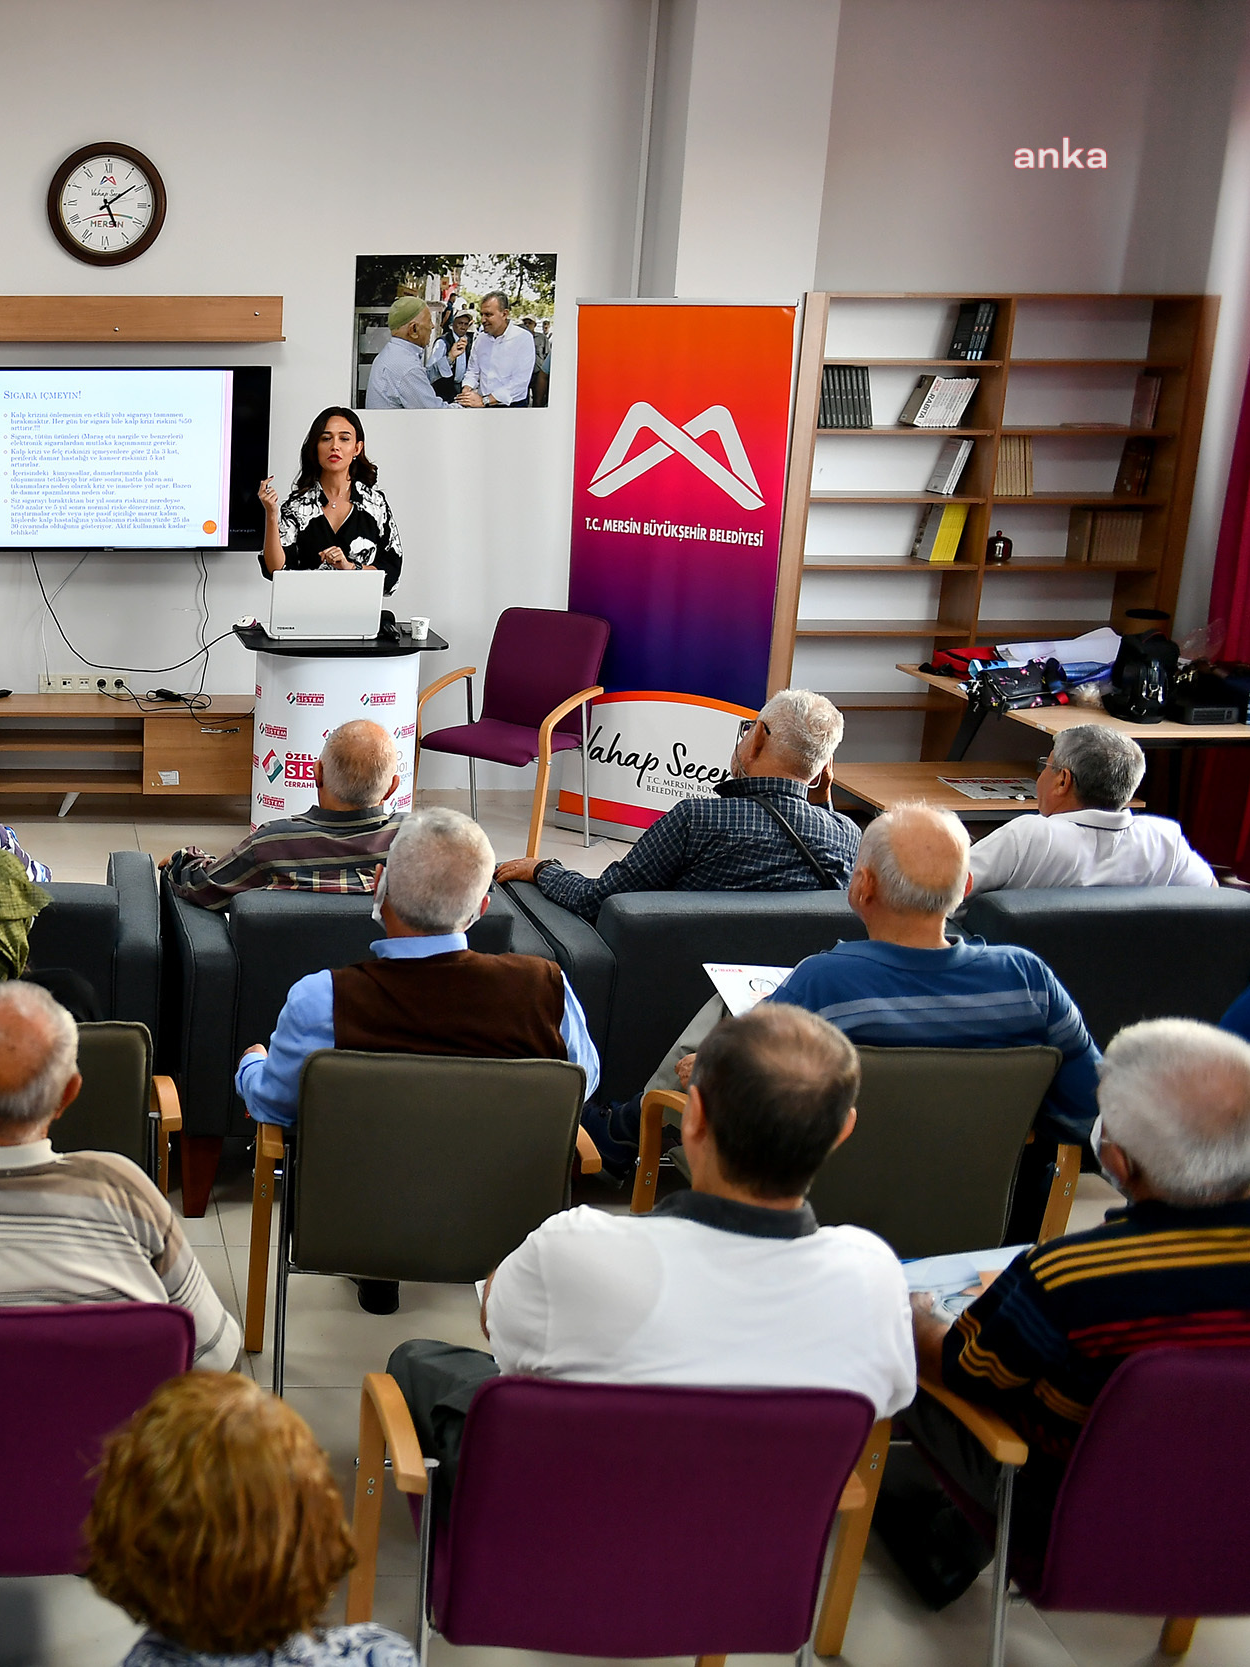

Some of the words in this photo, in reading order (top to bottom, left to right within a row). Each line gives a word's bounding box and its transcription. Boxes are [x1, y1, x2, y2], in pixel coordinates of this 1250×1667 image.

[585, 518, 601, 531] T.C.
[603, 518, 641, 534] MERSİN
[643, 519, 707, 542] BÜYÜKŞEHİR
[709, 528, 764, 547] BELEDİYESİ
[370, 695, 396, 703] SİSTEM
[287, 763, 315, 778] SİS
[284, 780, 315, 788] CERRAHİ
[646, 775, 661, 785] T.C.
[663, 778, 695, 791] MERSİN
[646, 786, 684, 798] BELEDİYE
